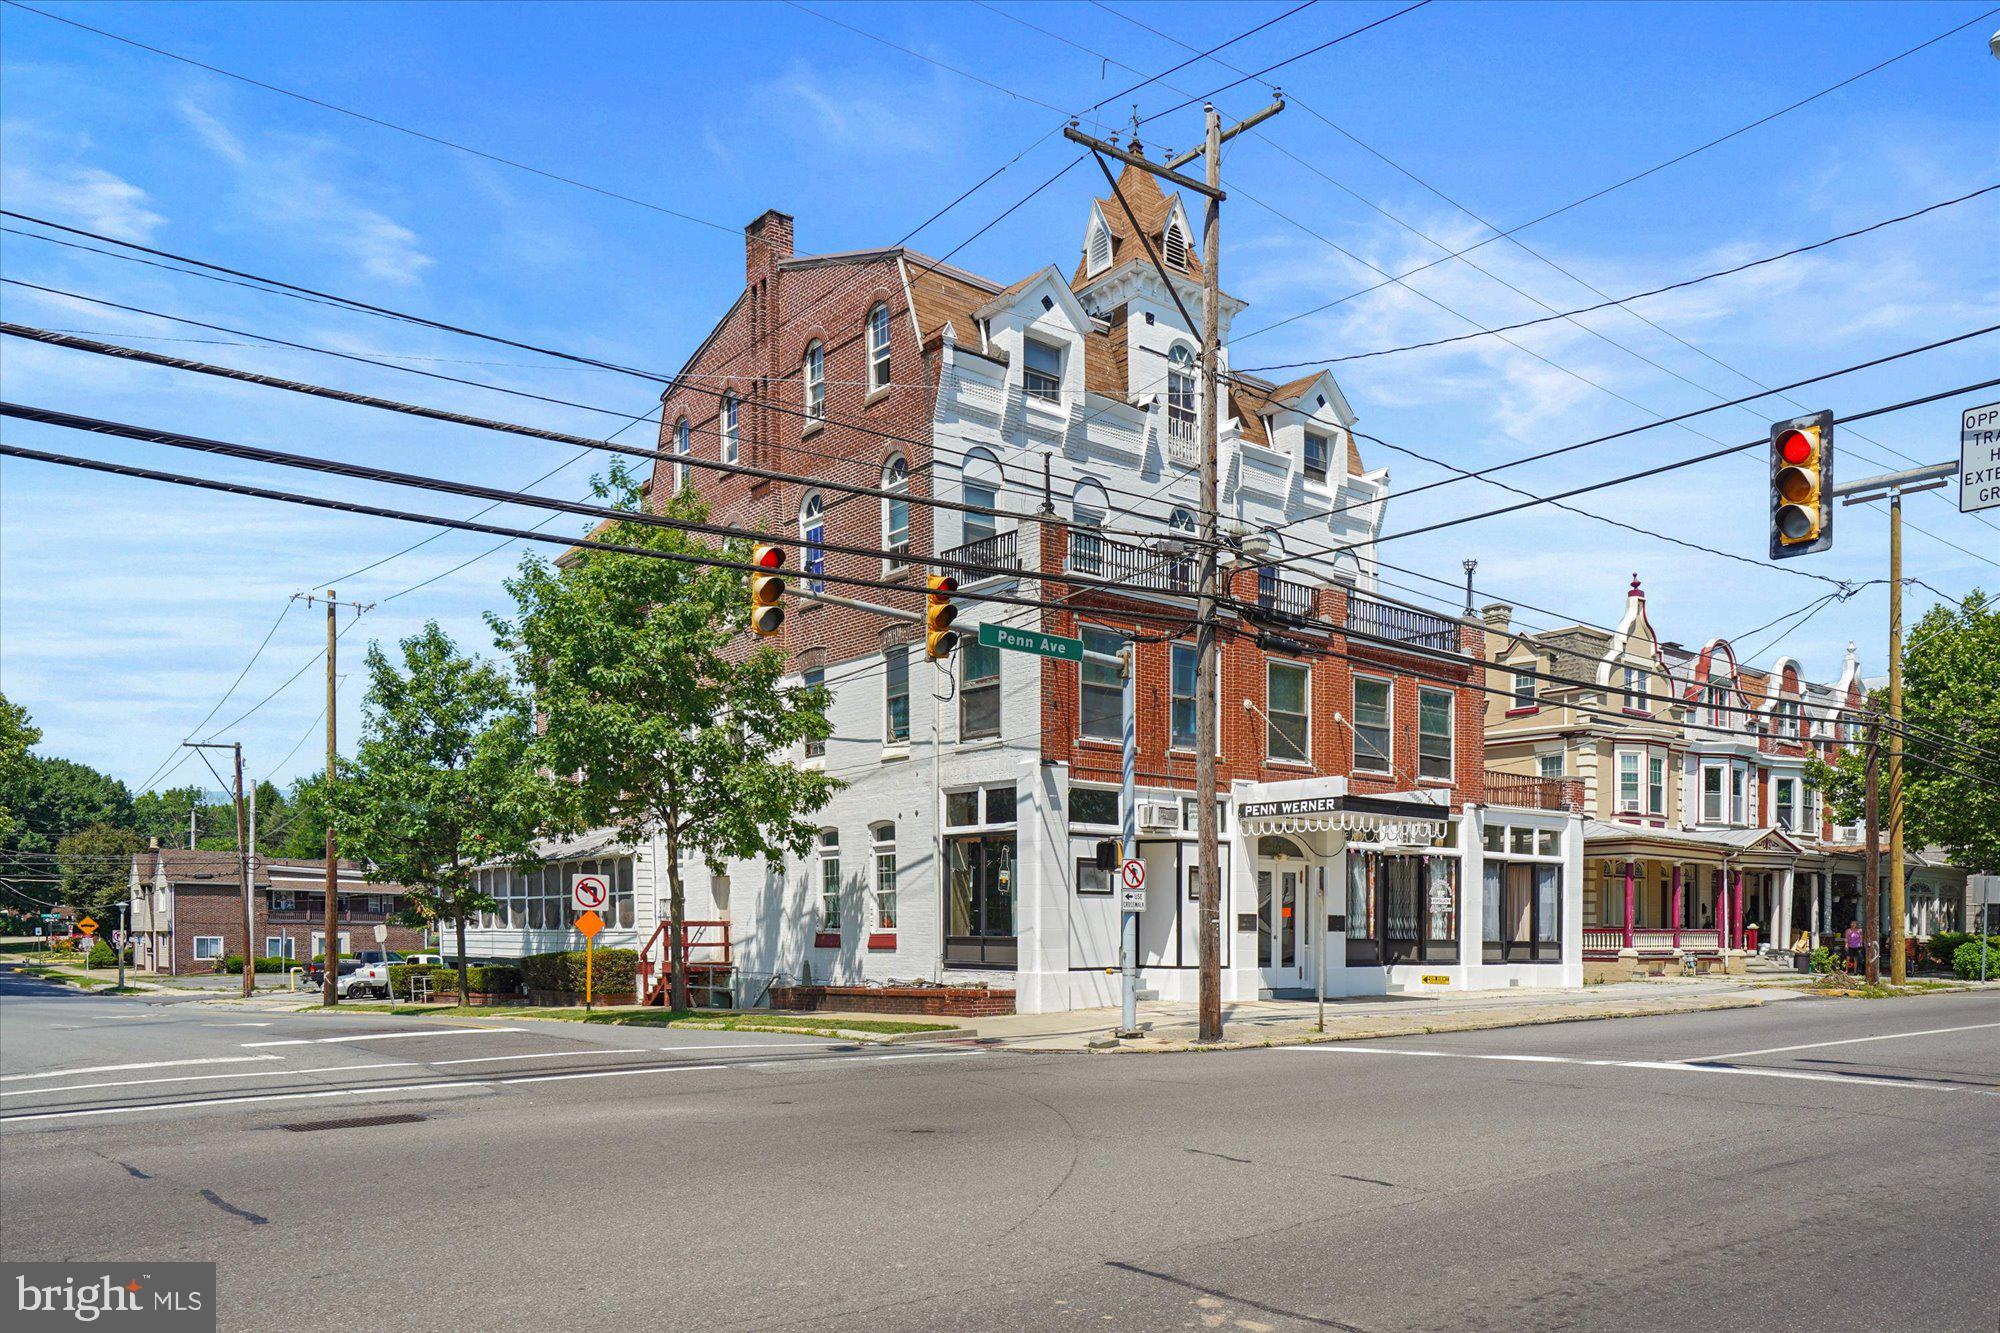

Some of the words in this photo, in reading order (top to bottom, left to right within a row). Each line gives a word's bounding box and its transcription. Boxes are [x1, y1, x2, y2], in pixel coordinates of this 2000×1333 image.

[1966, 410, 1999, 429] OPP
[1979, 486, 2000, 502] GR
[998, 630, 1033, 648] Penn
[1040, 638, 1066, 653] Ave
[1245, 803, 1277, 816] PENN
[1281, 798, 1335, 814] WERNER
